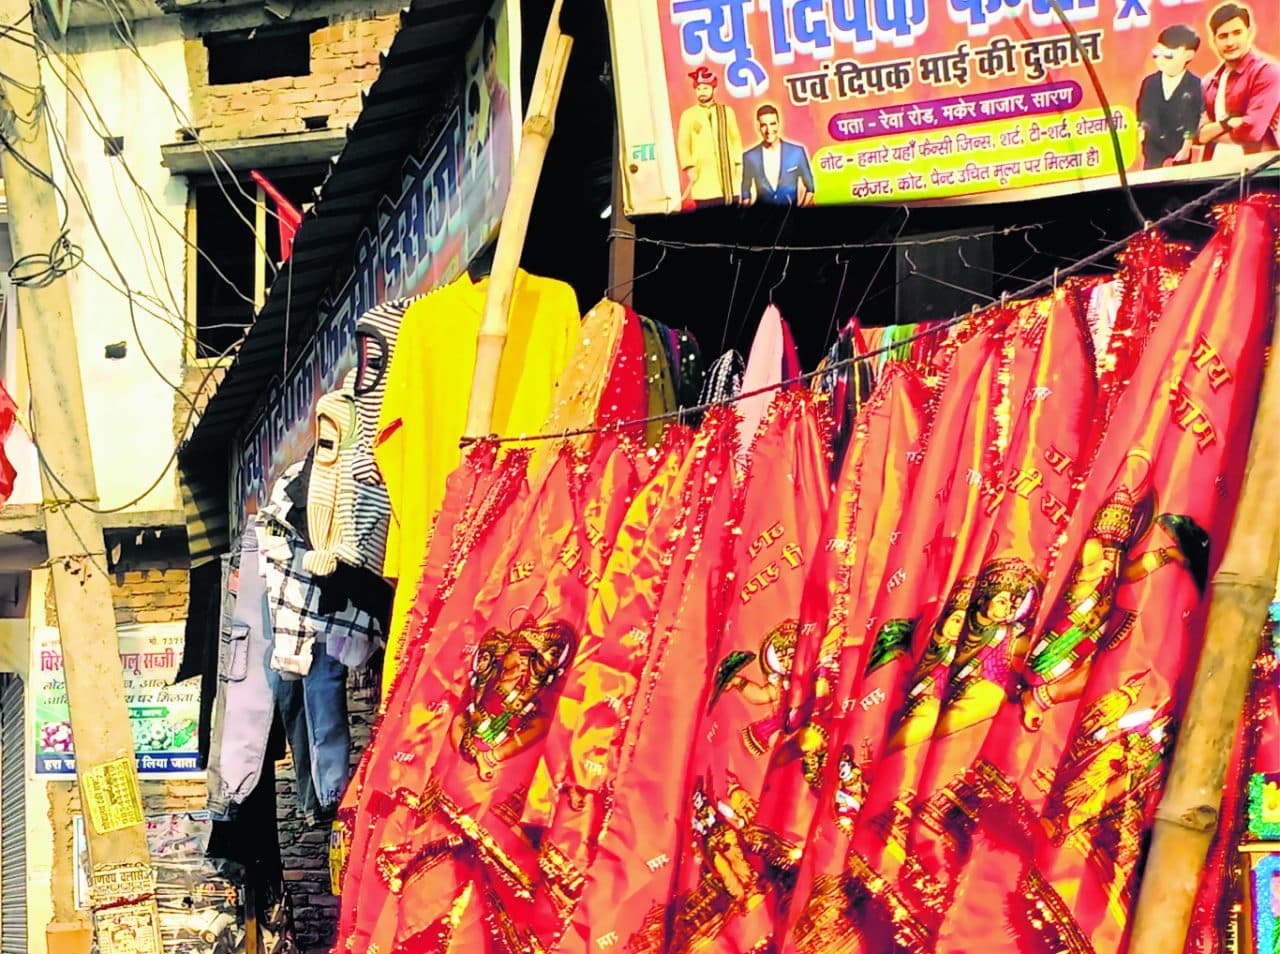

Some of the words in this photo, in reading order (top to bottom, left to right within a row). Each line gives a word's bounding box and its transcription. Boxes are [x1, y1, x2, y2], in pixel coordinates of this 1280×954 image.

[787, 64, 829, 102] एवं
[834, 59, 912, 93] दिपक
[920, 44, 969, 84] भाई
[976, 38, 1016, 76] की
[1022, 32, 1101, 79] दुकान
[836, 117, 864, 135] पता
[907, 104, 938, 126] रोड,
[942, 98, 976, 121] मकेर
[980, 94, 1028, 116] बाजार,
[1032, 87, 1073, 109] सारण
[820, 152, 843, 171] नोट
[858, 145, 889, 168] हमारे
[958, 163, 990, 184] उचित
[993, 160, 1020, 185] मूल्य
[1025, 158, 1041, 173] पर
[1044, 150, 1083, 172] मिलता
